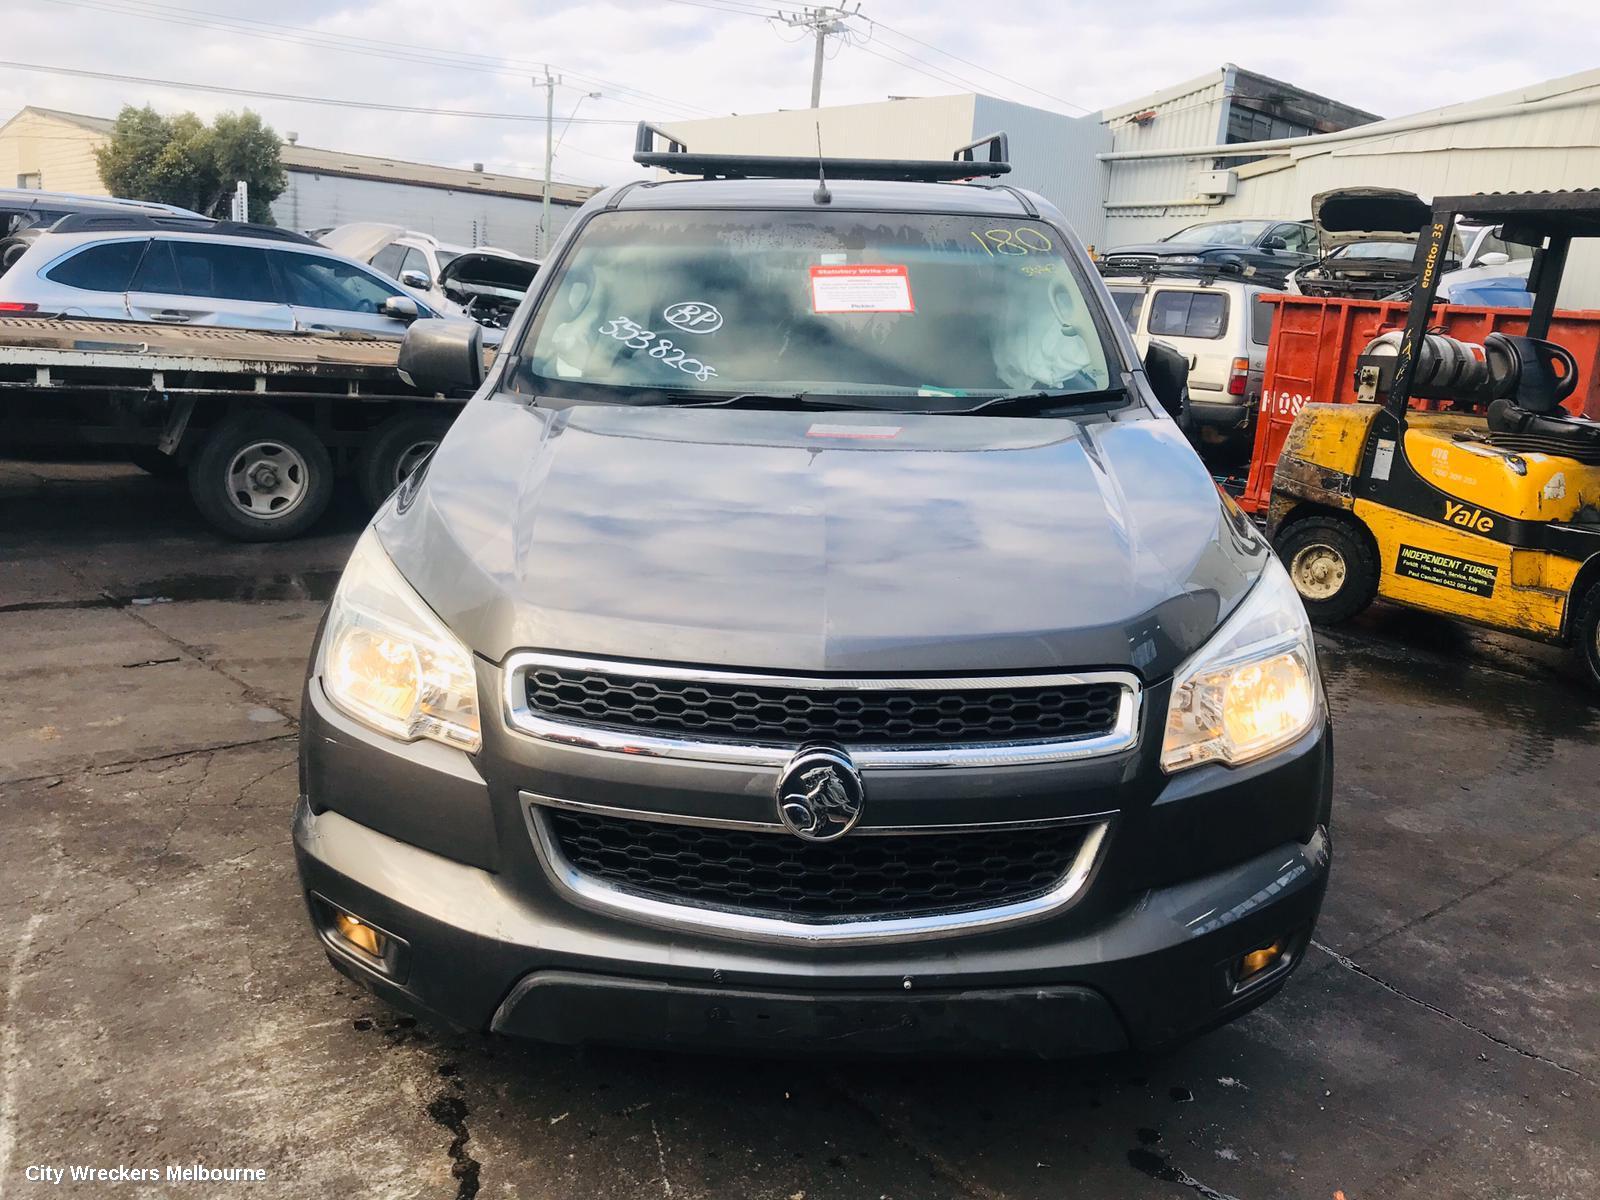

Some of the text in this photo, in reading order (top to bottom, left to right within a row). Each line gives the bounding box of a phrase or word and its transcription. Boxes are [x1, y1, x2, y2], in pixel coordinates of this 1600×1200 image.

[970, 227, 1052, 257] 180
[1432, 223, 1445, 239] 35
[669, 304, 717, 327] BP
[1443, 500, 1494, 533] Yale
[1401, 548, 1495, 579] INDEPENDENT FORKS
[1408, 570, 1420, 578] Paul
